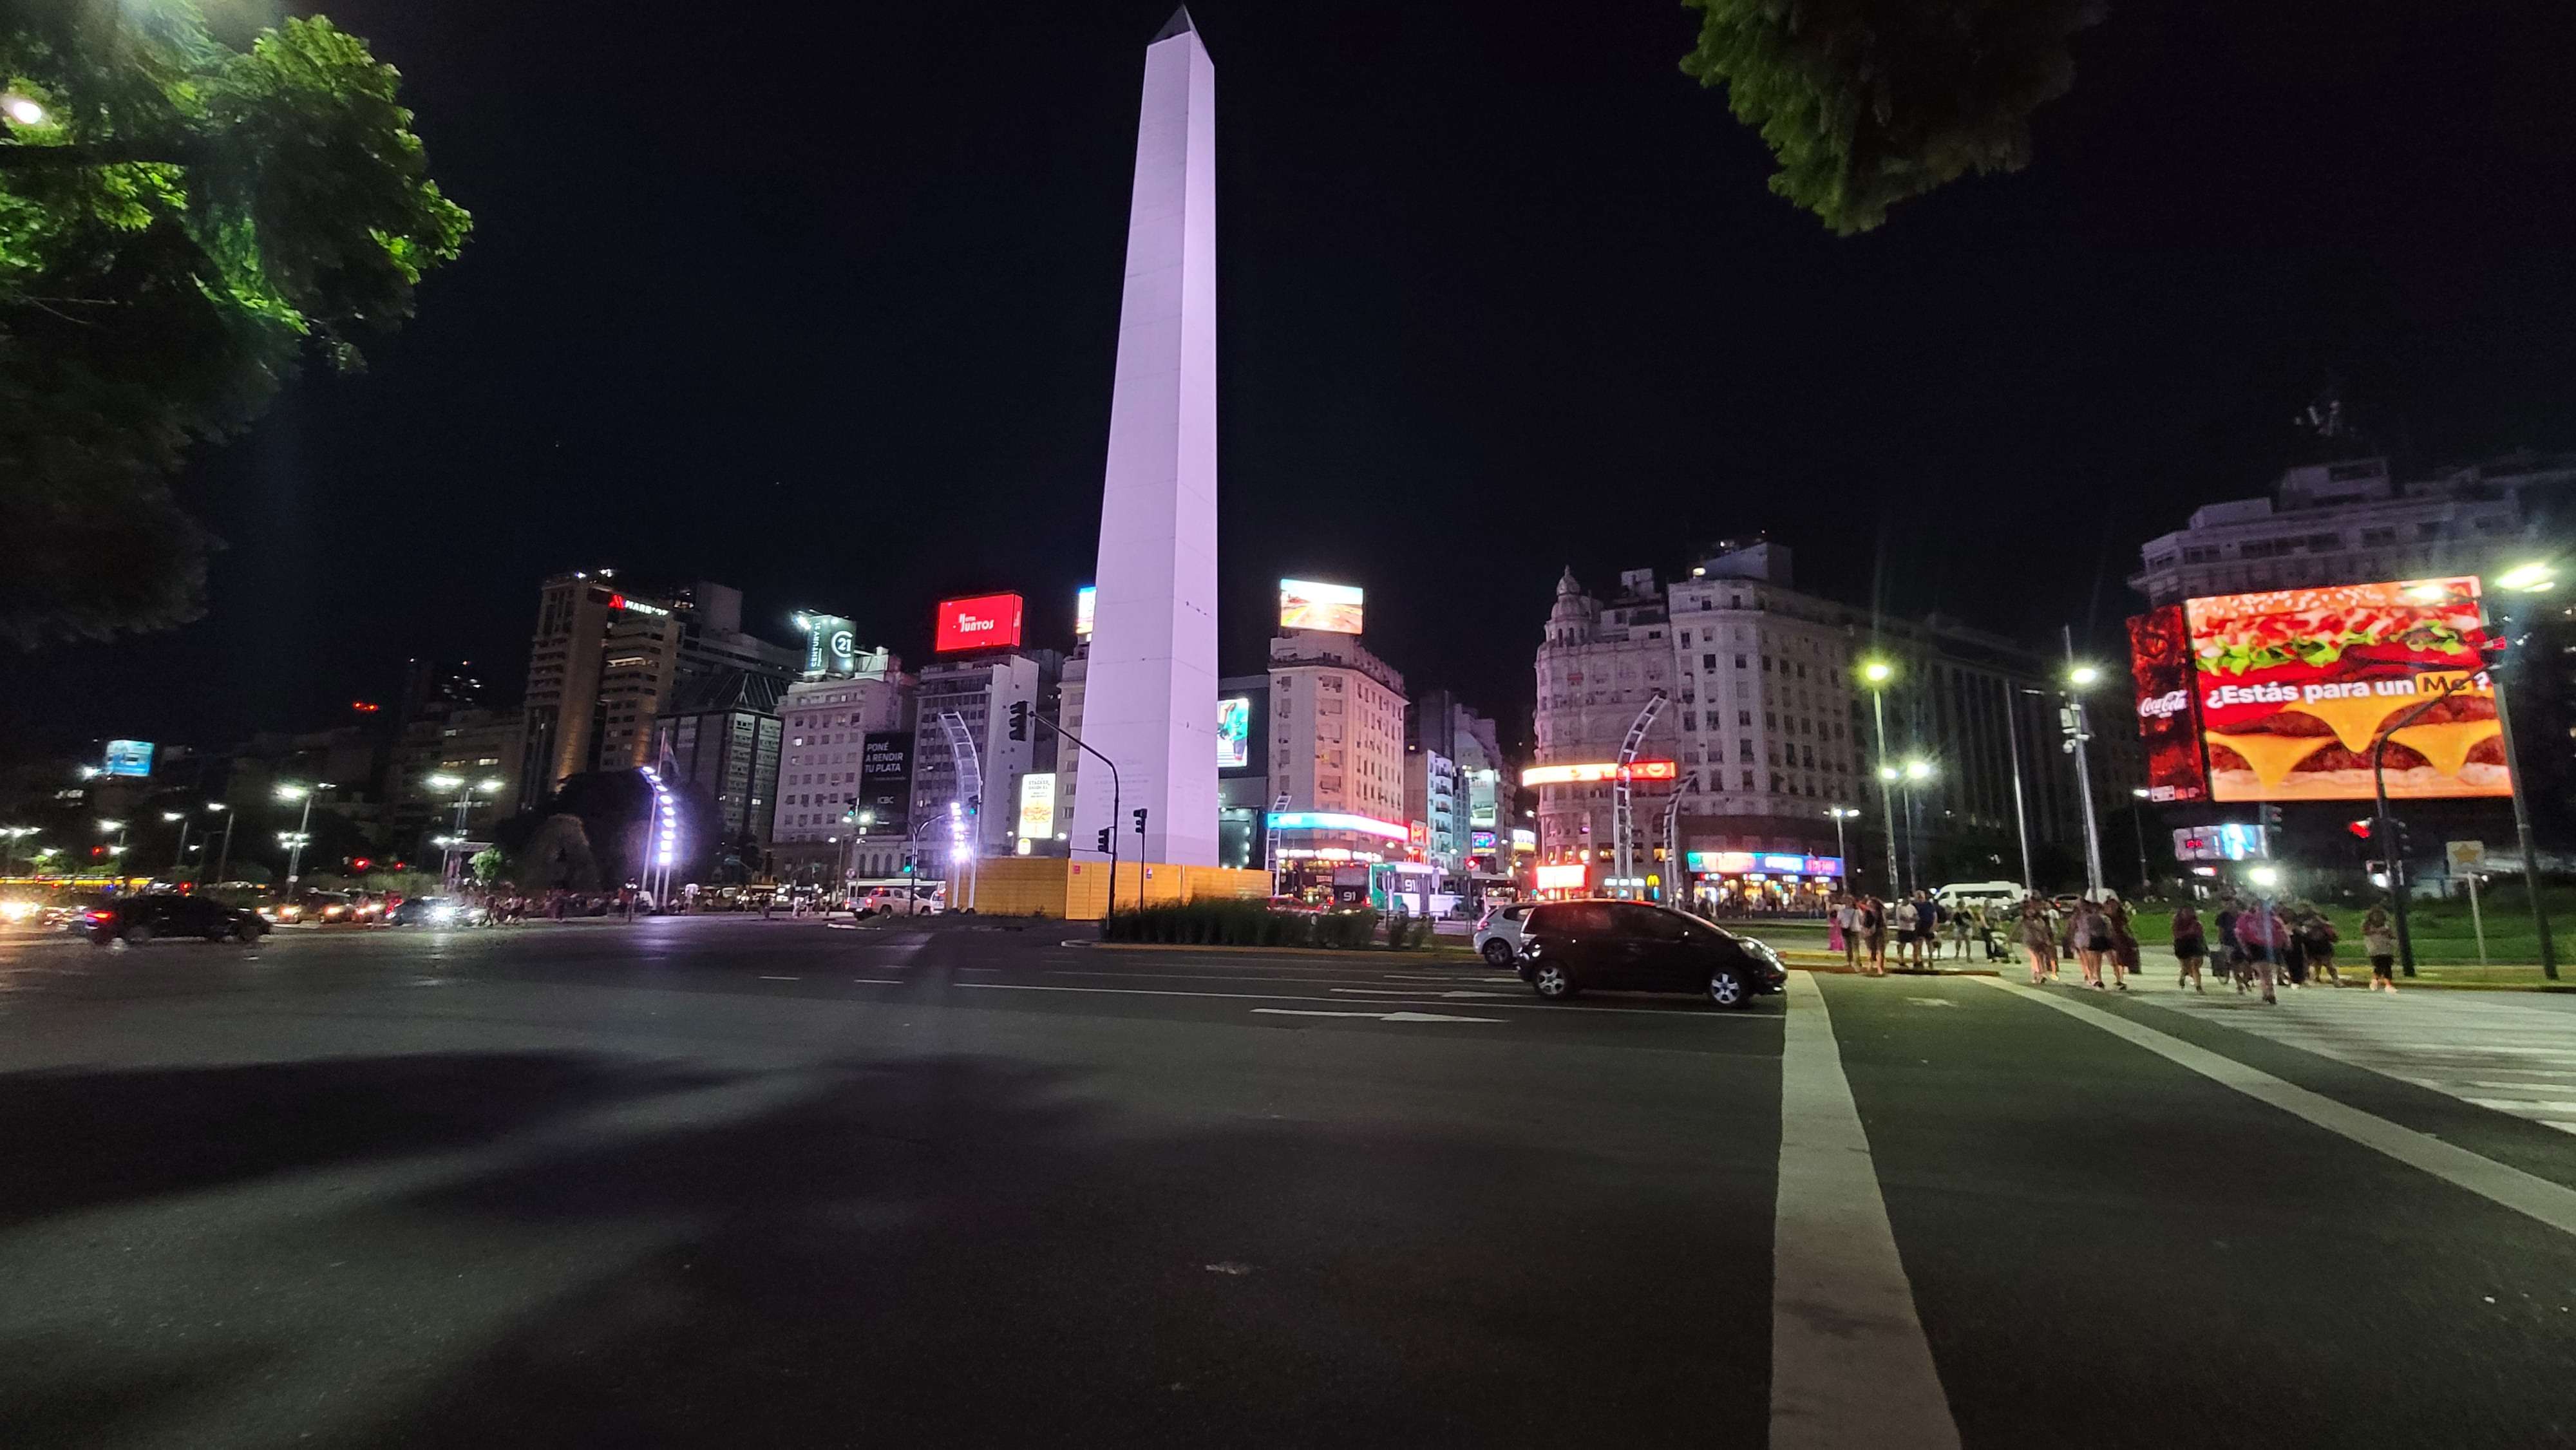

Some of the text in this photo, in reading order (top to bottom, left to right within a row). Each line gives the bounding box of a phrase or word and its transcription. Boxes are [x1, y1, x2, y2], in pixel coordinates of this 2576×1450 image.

[811, 632, 820, 667] CENTURY
[2206, 681, 2299, 708] ¿Estás
[2304, 680, 2371, 704] para
[2375, 678, 2415, 696] un
[867, 740, 889, 751] PONÉ
[873, 752, 904, 762] RENDIR
[866, 763, 901, 773] TU PLATA
[877, 796, 895, 804] ICBC
[1405, 879, 1416, 891] 91
[1343, 891, 1356, 901] 91
